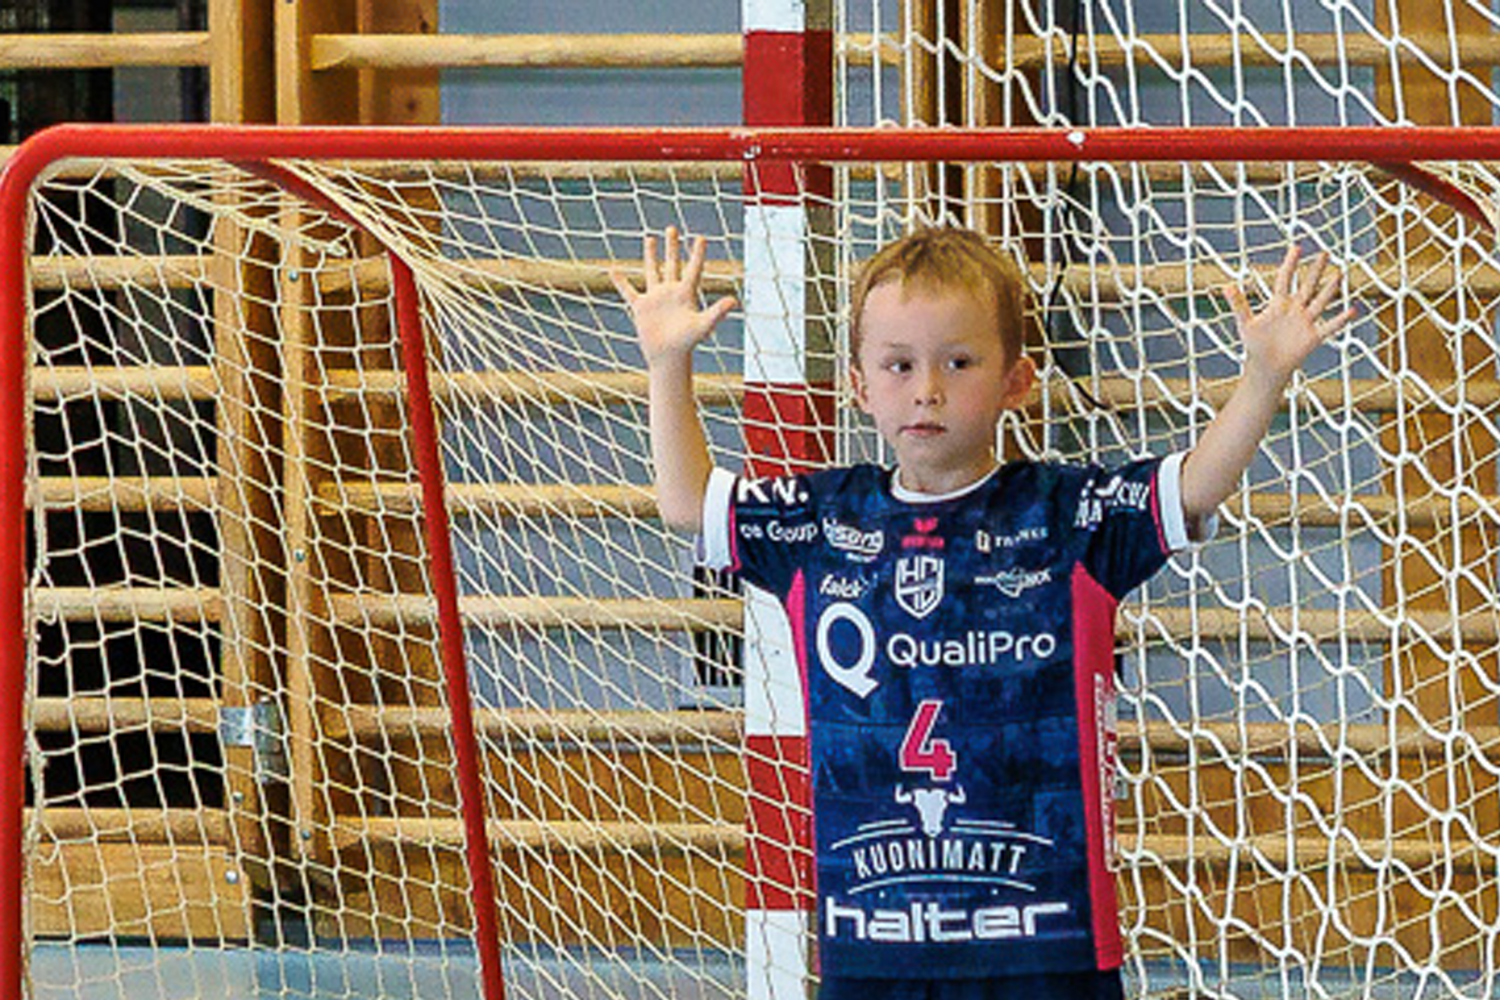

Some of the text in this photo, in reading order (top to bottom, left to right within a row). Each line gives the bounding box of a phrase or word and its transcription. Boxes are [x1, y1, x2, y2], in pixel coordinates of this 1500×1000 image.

[887, 630, 1056, 668] QualiPro
[899, 699, 957, 782] 4
[852, 838, 1026, 878] KUONIMATT
[825, 896, 1069, 942] halter
